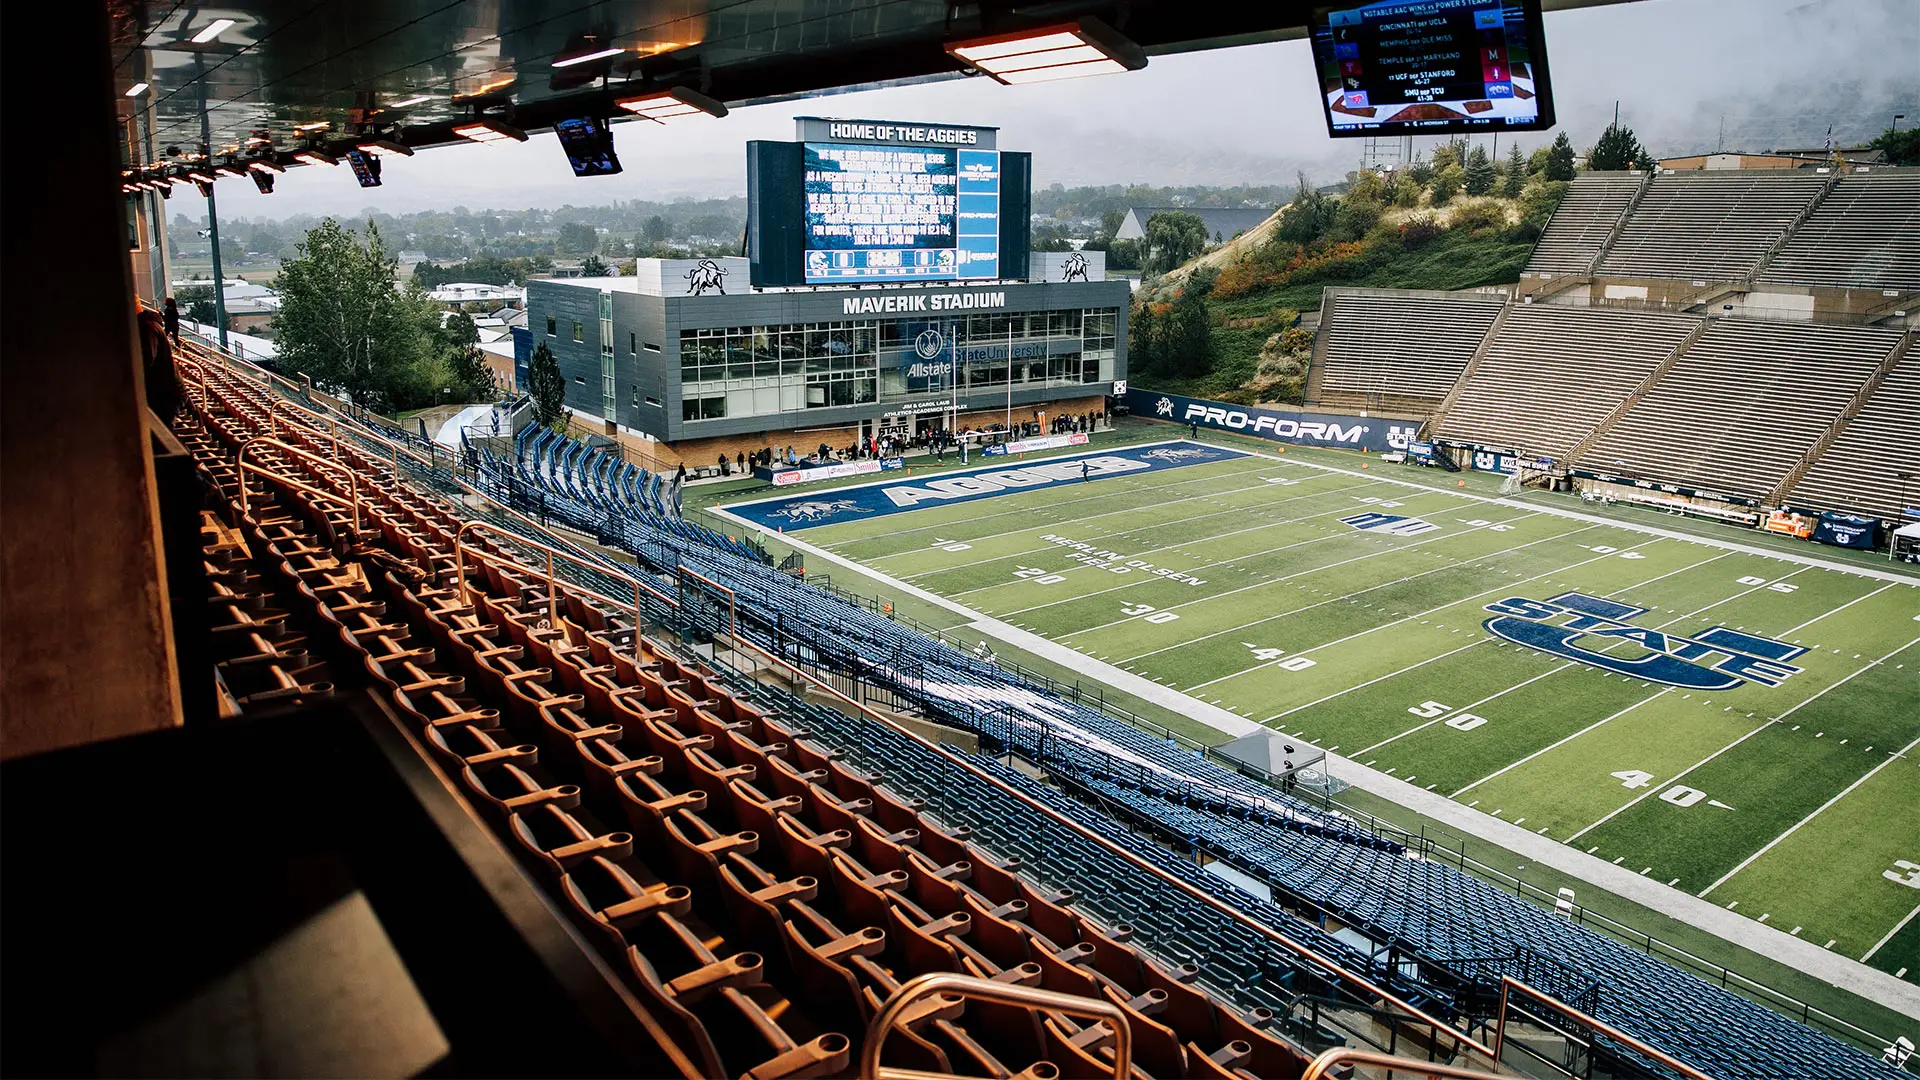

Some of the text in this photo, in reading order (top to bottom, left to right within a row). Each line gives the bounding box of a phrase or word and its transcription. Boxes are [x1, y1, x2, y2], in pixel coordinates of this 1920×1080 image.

[1364, 9, 1392, 18] NOTABLE
[1394, 6, 1407, 14] AAC
[1408, 4, 1426, 12] WINS
[1435, 0, 1460, 10] POWER
[1380, 22, 1417, 31] CINCINNATI
[1380, 39, 1409, 47] MEMPHIS
[1424, 52, 1460, 60] MARYLAND
[1420, 70, 1456, 78] STANFORD
[830, 124, 976, 144] HOME OF THE AGGIES
[807, 171, 815, 181] AS
[816, 171, 820, 181] A
[844, 183, 863, 192] POLICE
[808, 194, 818, 203] WE
[820, 194, 831, 203] ASK
[813, 226, 824, 235] FOR
[853, 226, 873, 235] PLEASE
[843, 292, 1005, 314] MAVERIK STADIUM
[906, 362, 951, 378] Allstate
[881, 456, 1151, 507] AGGIES
[931, 540, 973, 552] 10
[1039, 534, 1208, 586] MERLIN OLSEN
[1064, 552, 1132, 574] FIELD
[1012, 568, 1067, 585] 20
[1120, 604, 1180, 624] 30
[1250, 647, 1318, 672] 40
[1408, 700, 1488, 732] 50
[1610, 770, 1709, 807] 40
